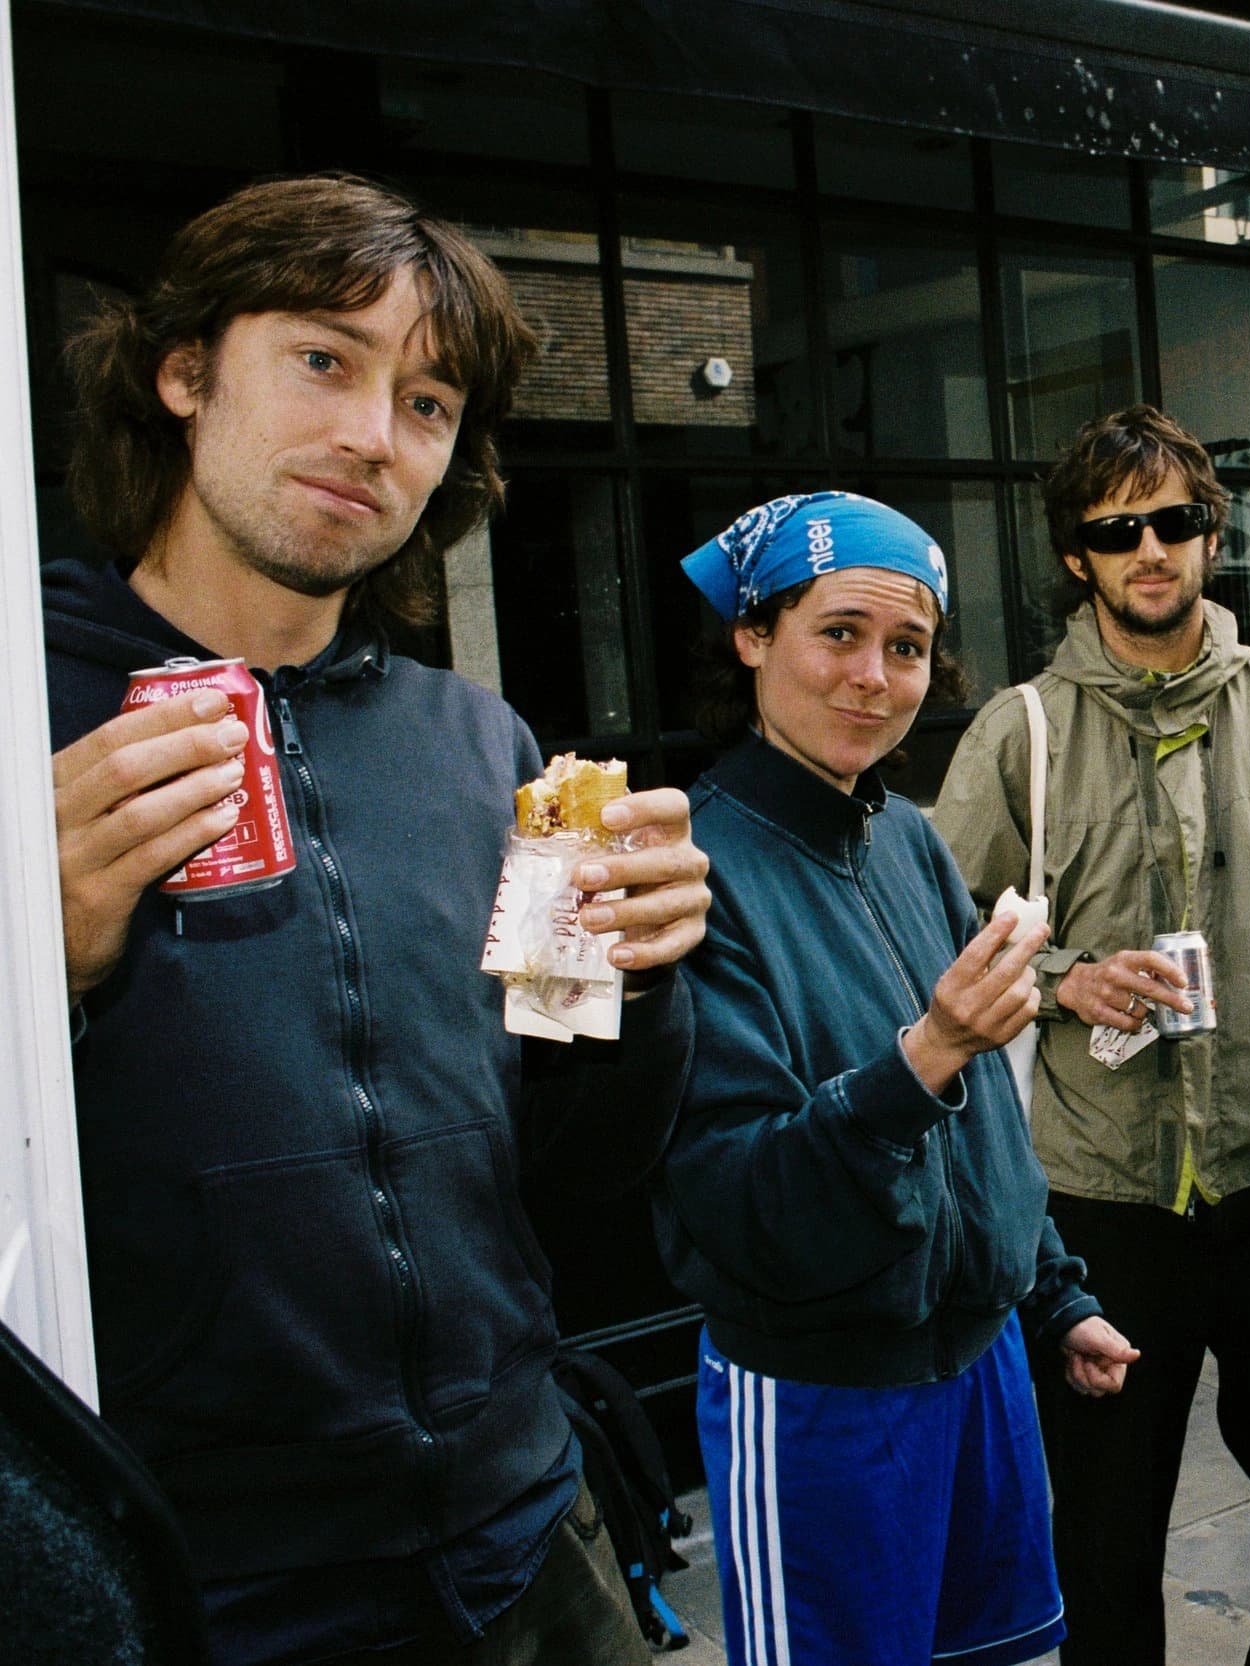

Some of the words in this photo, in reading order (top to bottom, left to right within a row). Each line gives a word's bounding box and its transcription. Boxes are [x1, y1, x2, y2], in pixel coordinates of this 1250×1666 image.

[129, 685, 164, 705] Coke
[171, 676, 225, 692] ORIGINAL
[259, 765, 272, 790] ME
[264, 791, 287, 861] RECYCLE
